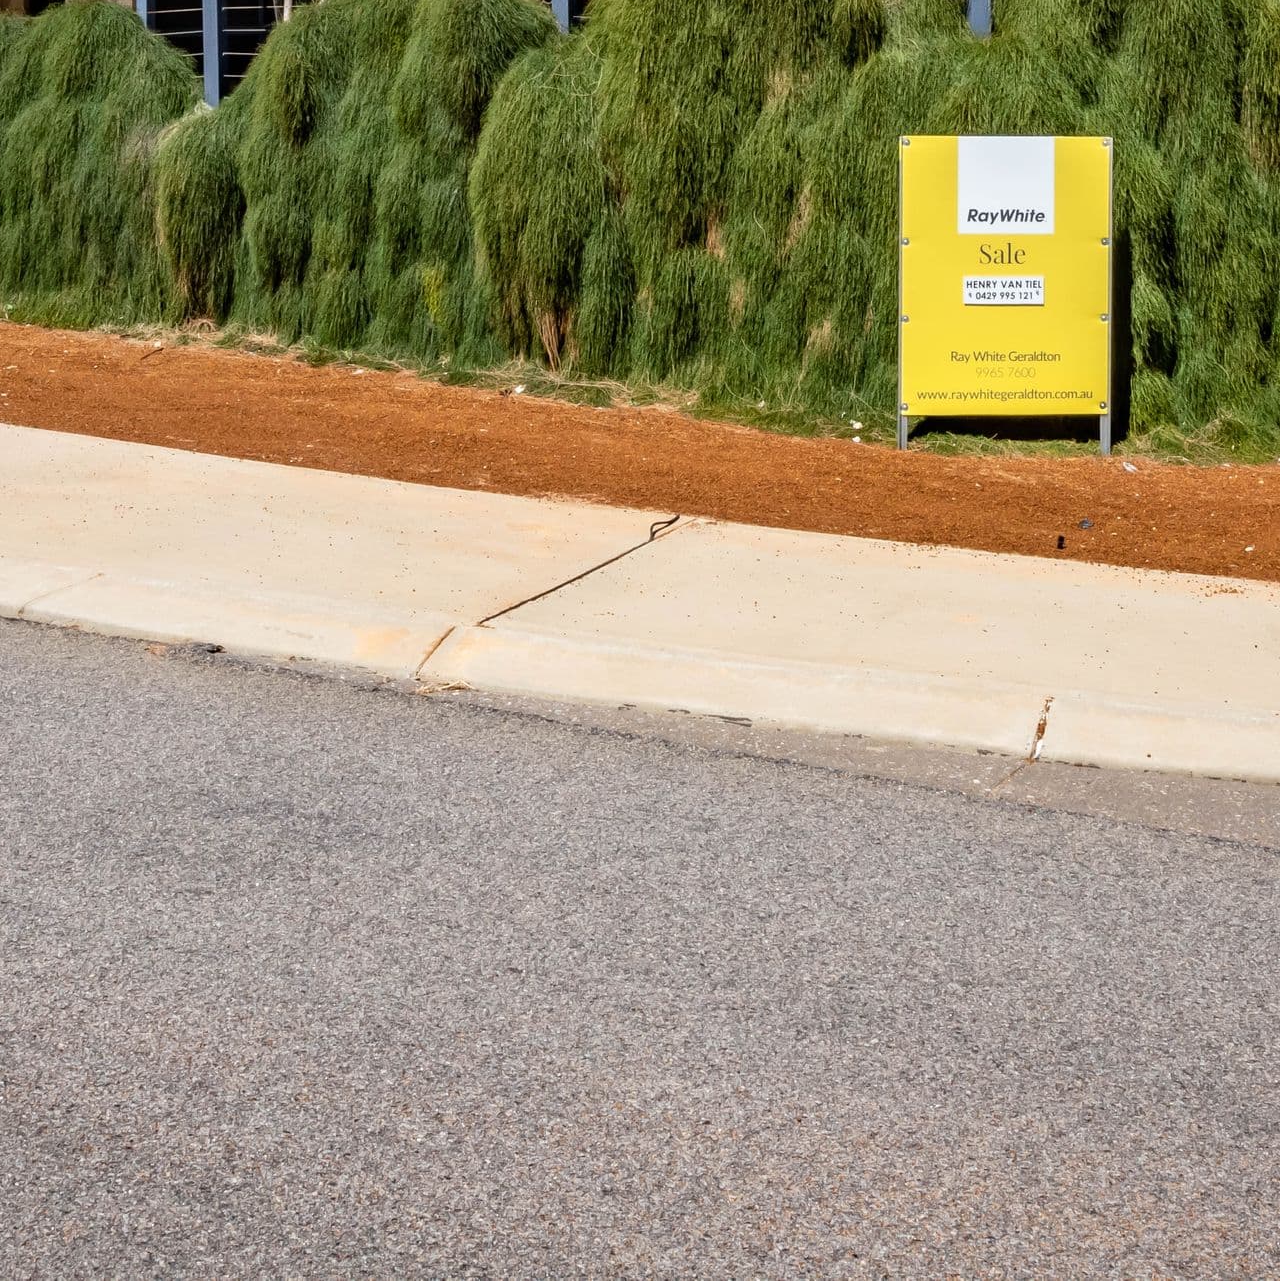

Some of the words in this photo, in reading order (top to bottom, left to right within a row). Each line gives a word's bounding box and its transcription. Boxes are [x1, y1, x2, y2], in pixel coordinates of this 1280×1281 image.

[967, 208, 1046, 225] RayWhite
[979, 243, 1026, 265] Sale
[966, 280, 998, 289] HENRY
[1001, 280, 1023, 289] VAN
[1025, 280, 1042, 289] TIEL
[975, 291, 997, 300] 0429
[999, 291, 1016, 300] 995
[1019, 291, 1033, 300] 121
[950, 351, 971, 363] Ray
[973, 350, 1007, 362] White
[1008, 350, 1061, 362] Geraldton
[975, 367, 1004, 379] 9965
[1008, 367, 1036, 379] 7600
[917, 388, 1093, 401] www.raywhitegeraldton.com.au
